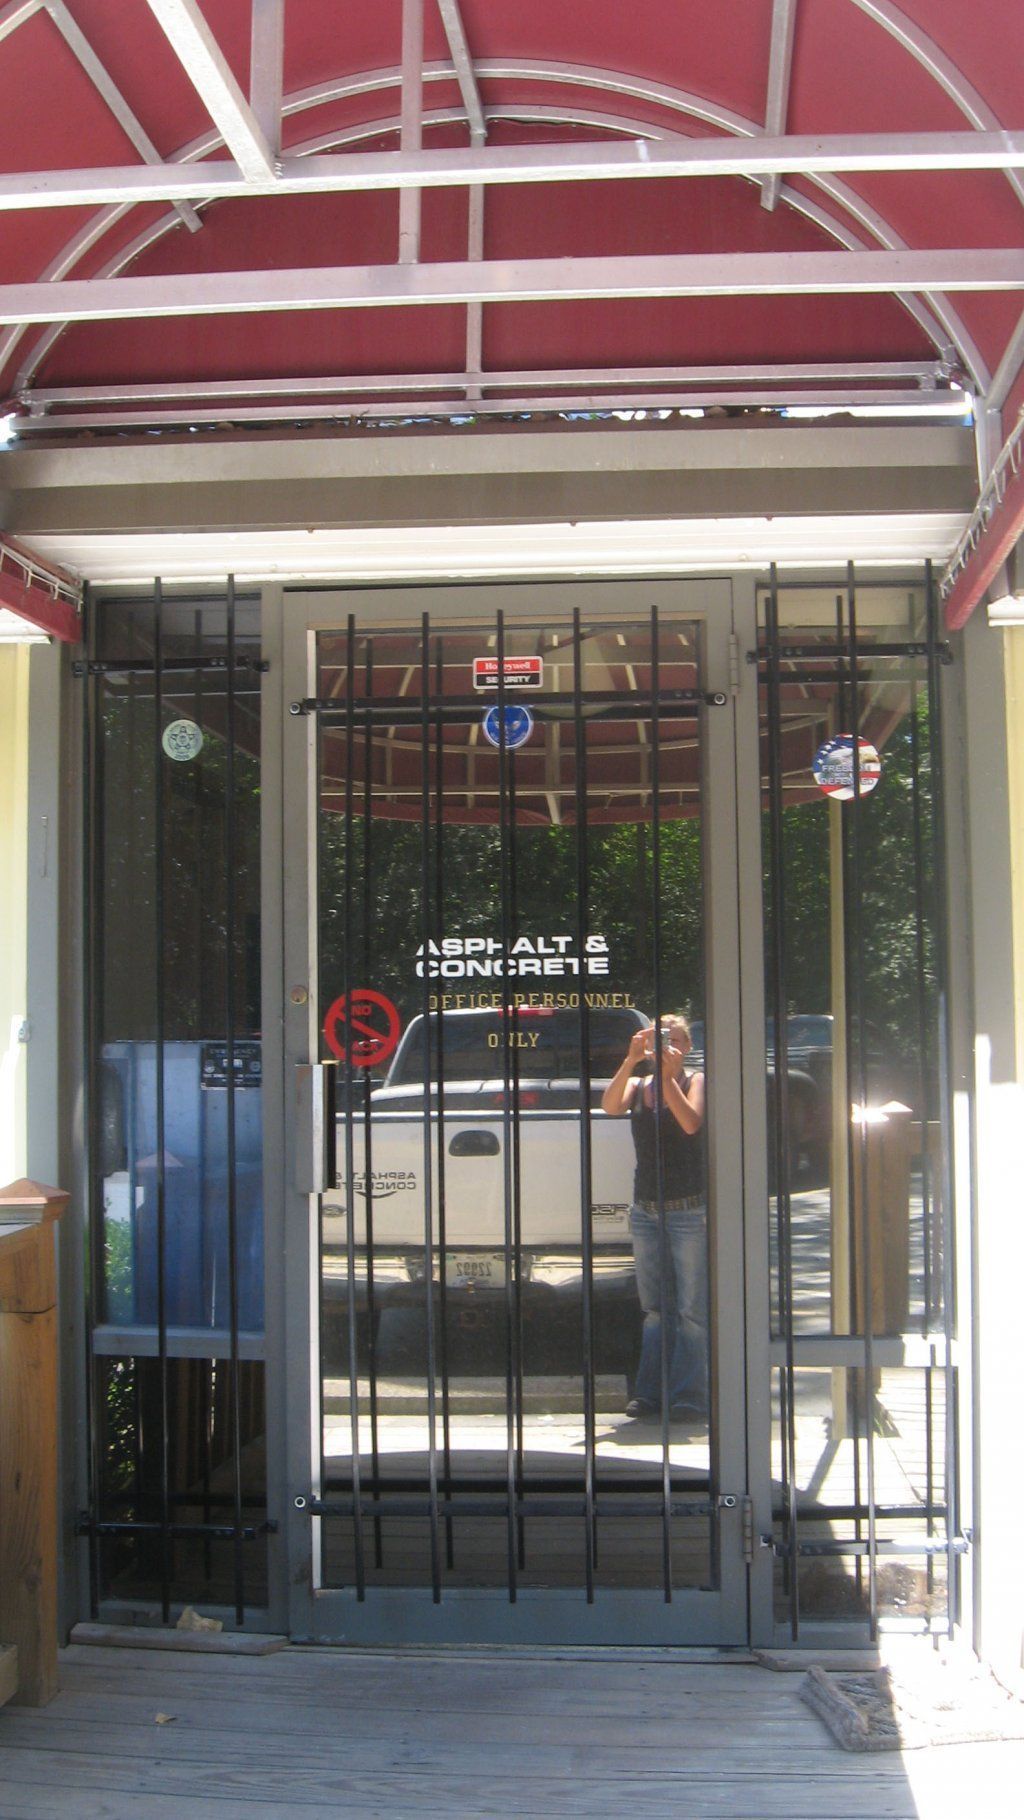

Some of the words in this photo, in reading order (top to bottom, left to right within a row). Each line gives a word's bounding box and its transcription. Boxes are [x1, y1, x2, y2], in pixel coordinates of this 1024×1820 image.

[485, 661, 531, 671] Hoeywell
[486, 675, 531, 684] SEURITY
[820, 777, 874, 785] DEFENED
[416, 936, 573, 957] ASPHALT
[585, 935, 610, 954] &
[416, 957, 610, 978] CONCRETE
[428, 994, 502, 1010] OFFICE
[514, 993, 636, 1008] PERSONNEL
